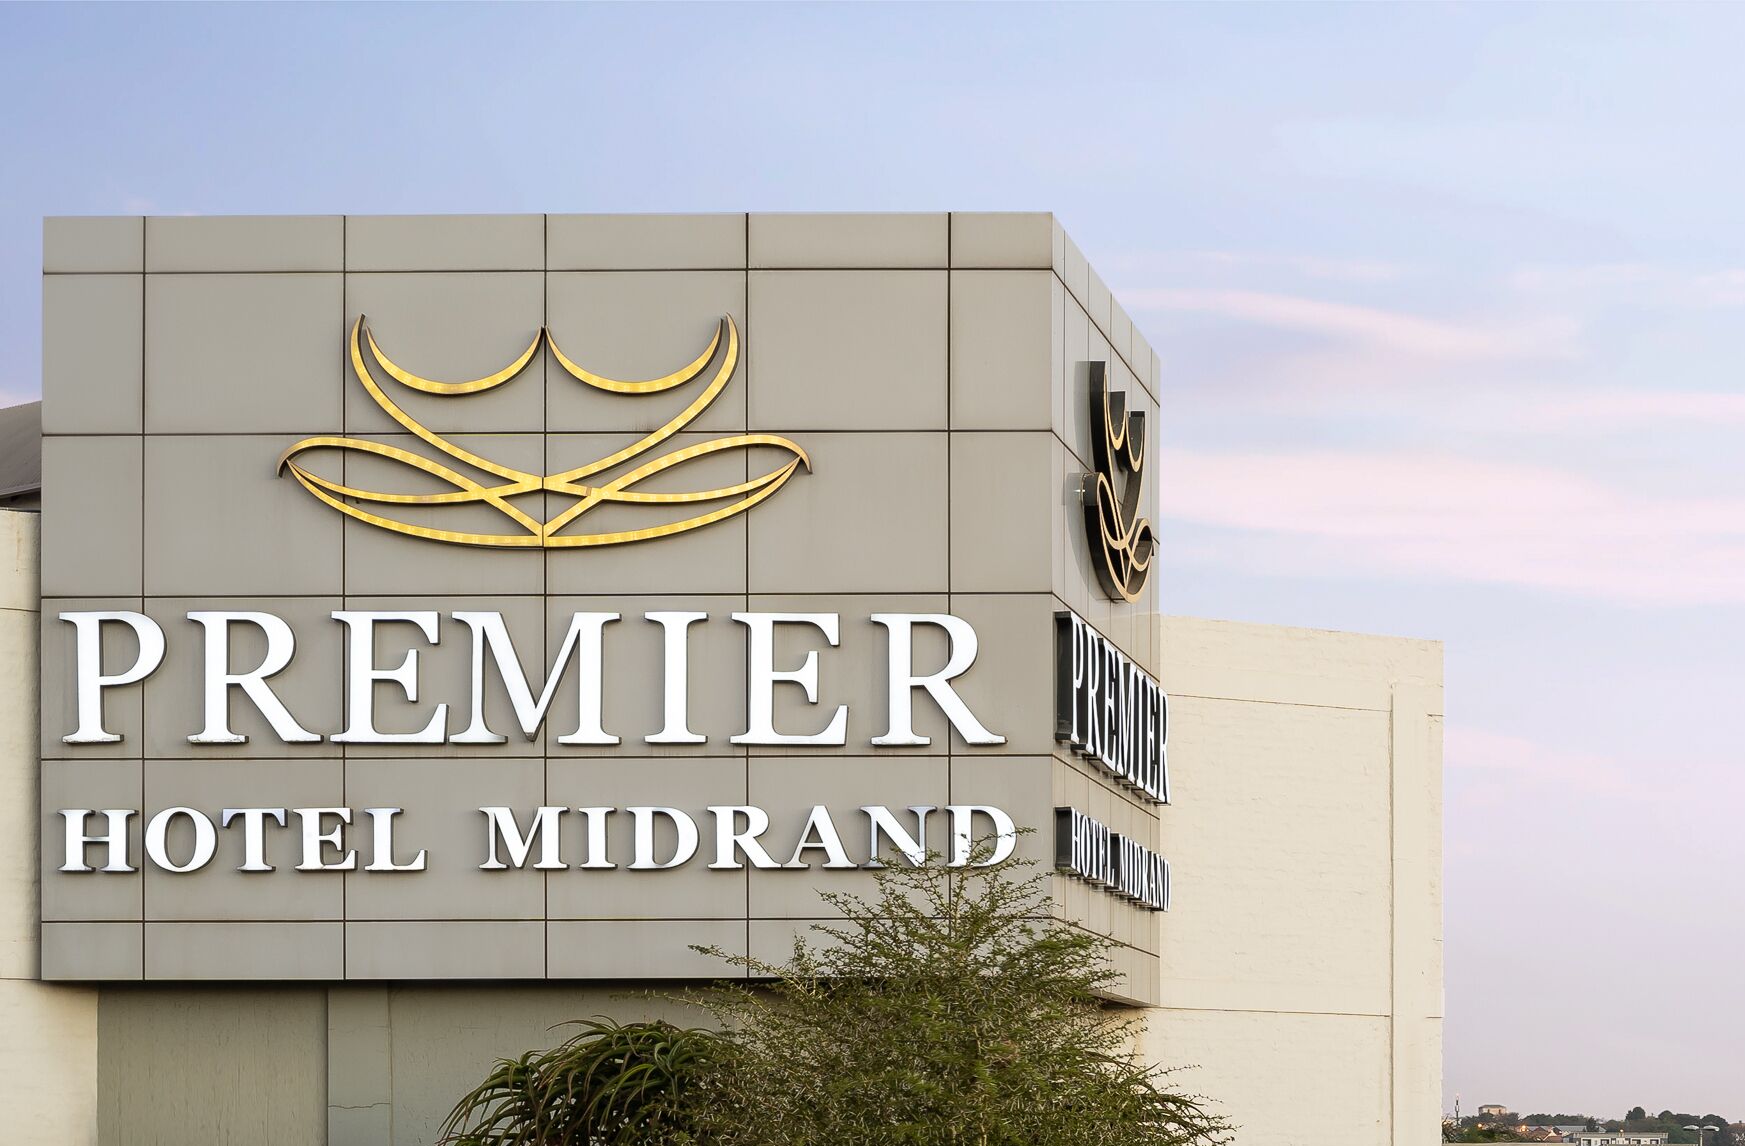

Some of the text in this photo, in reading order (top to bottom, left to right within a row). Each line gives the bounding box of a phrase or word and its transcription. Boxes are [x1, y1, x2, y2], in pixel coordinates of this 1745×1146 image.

[58, 611, 1006, 745] PREMIER
[1070, 611, 1171, 804] PREMIER
[58, 805, 1018, 873] HOTEL MIDRAND
[1070, 807, 1172, 912] HOTEL MIDRAND
